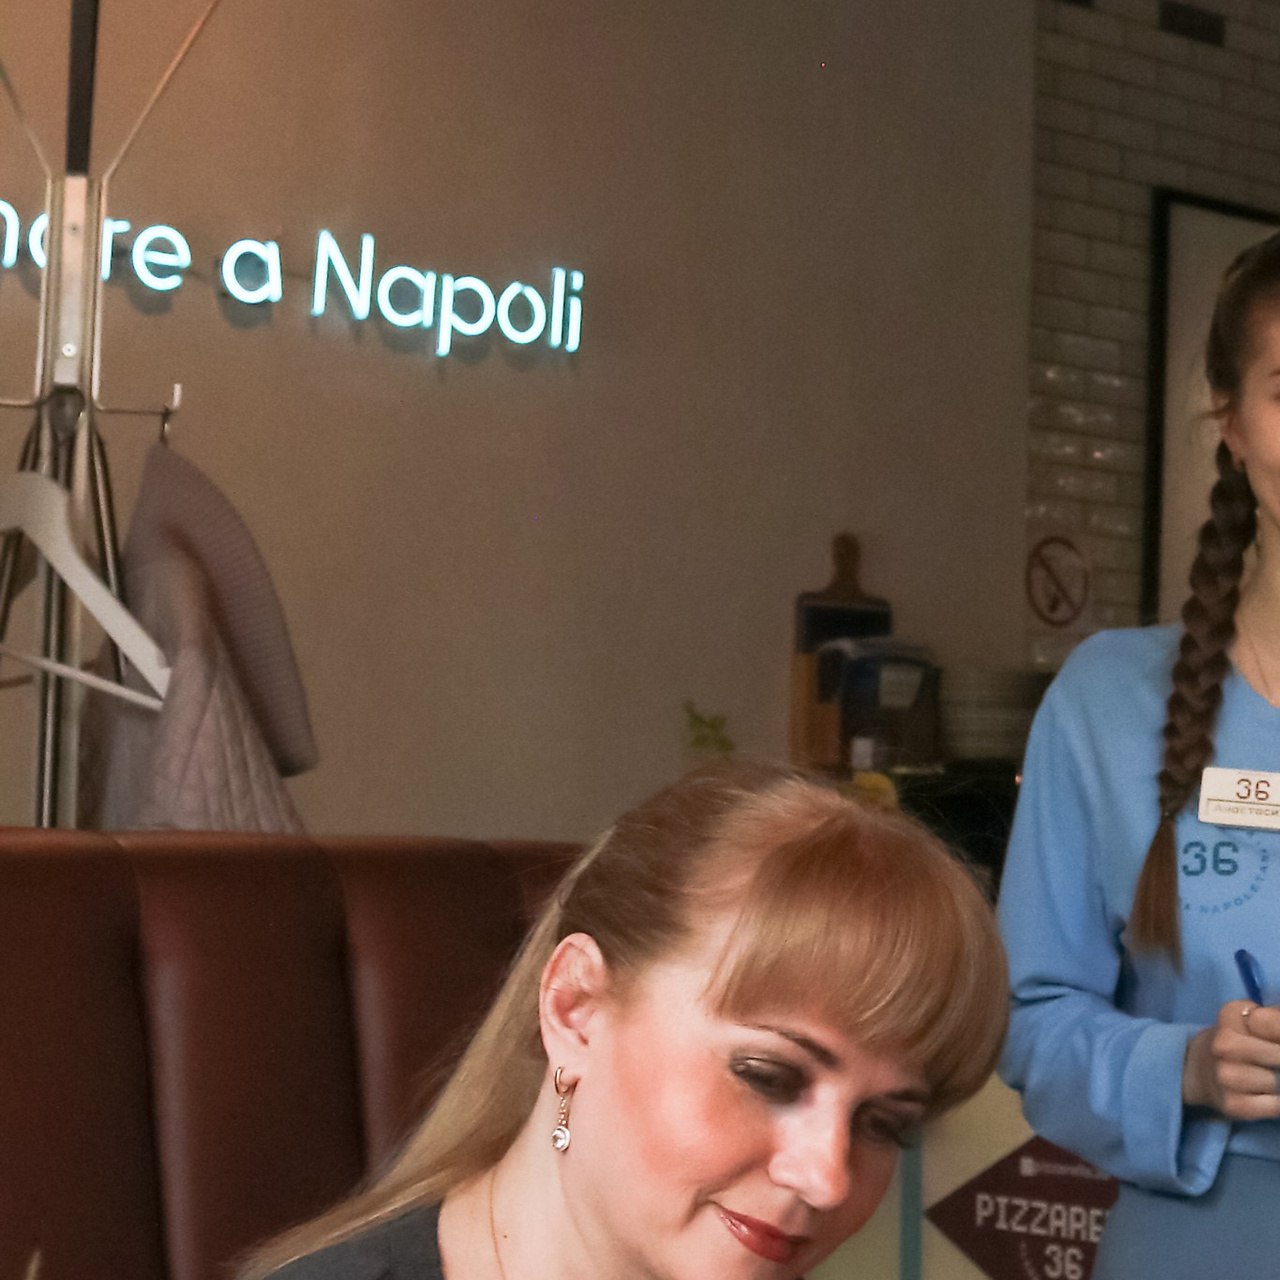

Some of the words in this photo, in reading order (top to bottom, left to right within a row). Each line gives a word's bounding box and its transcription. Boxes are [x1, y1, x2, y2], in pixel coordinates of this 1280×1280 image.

[221, 236, 283, 305] a
[310, 227, 585, 358] Napoli
[1235, 778, 1271, 802] 36
[1181, 840, 1240, 877] 36
[974, 1191, 1109, 1244] PIZZARE
[1043, 1243, 1084, 1280] 36
